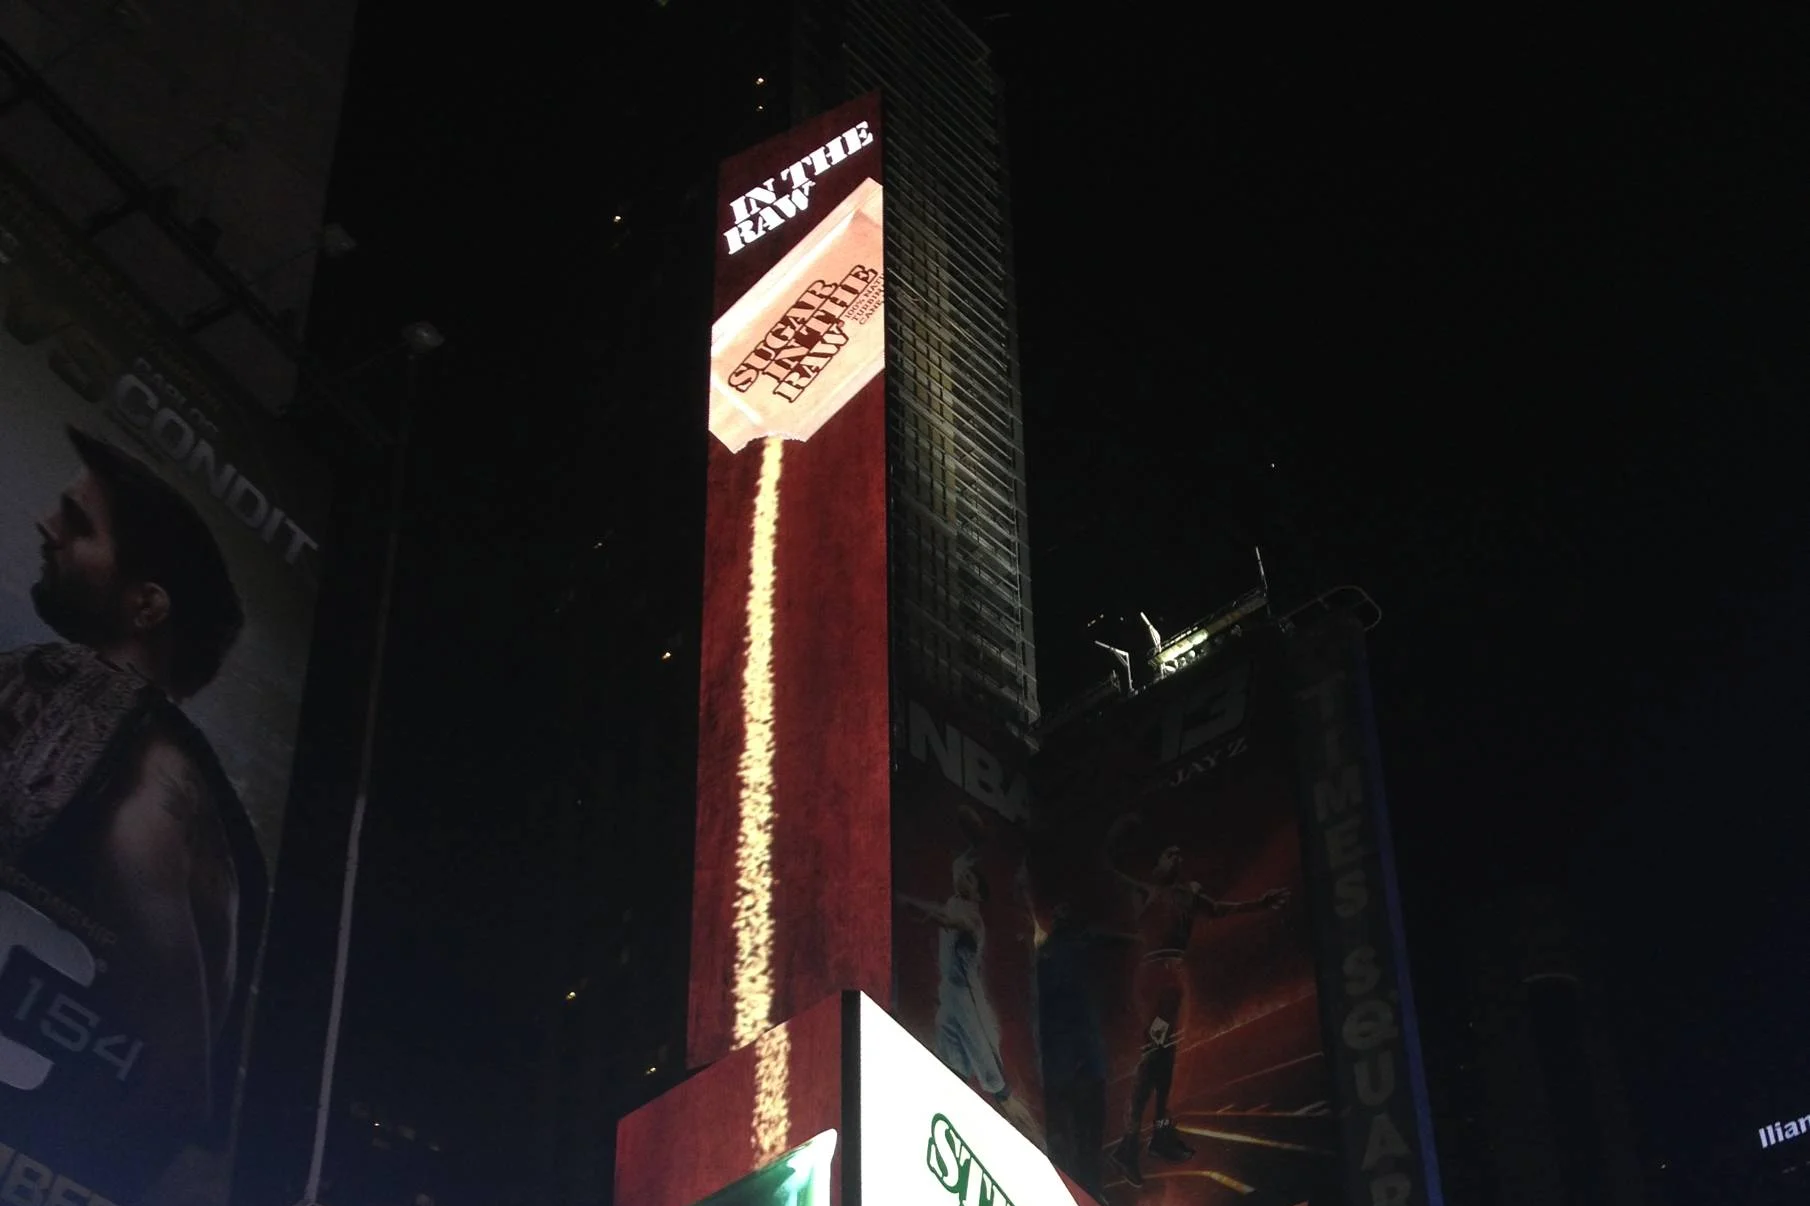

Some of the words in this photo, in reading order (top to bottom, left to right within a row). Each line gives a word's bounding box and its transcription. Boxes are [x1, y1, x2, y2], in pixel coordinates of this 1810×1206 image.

[723, 181, 816, 255] RAW
[729, 177, 777, 225] IN
[780, 121, 873, 189] THE
[728, 280, 838, 392] SUGAR
[762, 335, 813, 383] IN
[800, 264, 878, 342] THE
[772, 322, 849, 403] RAW
[114, 373, 320, 566] CONDIT
[1298, 672, 1369, 918] TIMES
[14, 976, 146, 1083] 154
